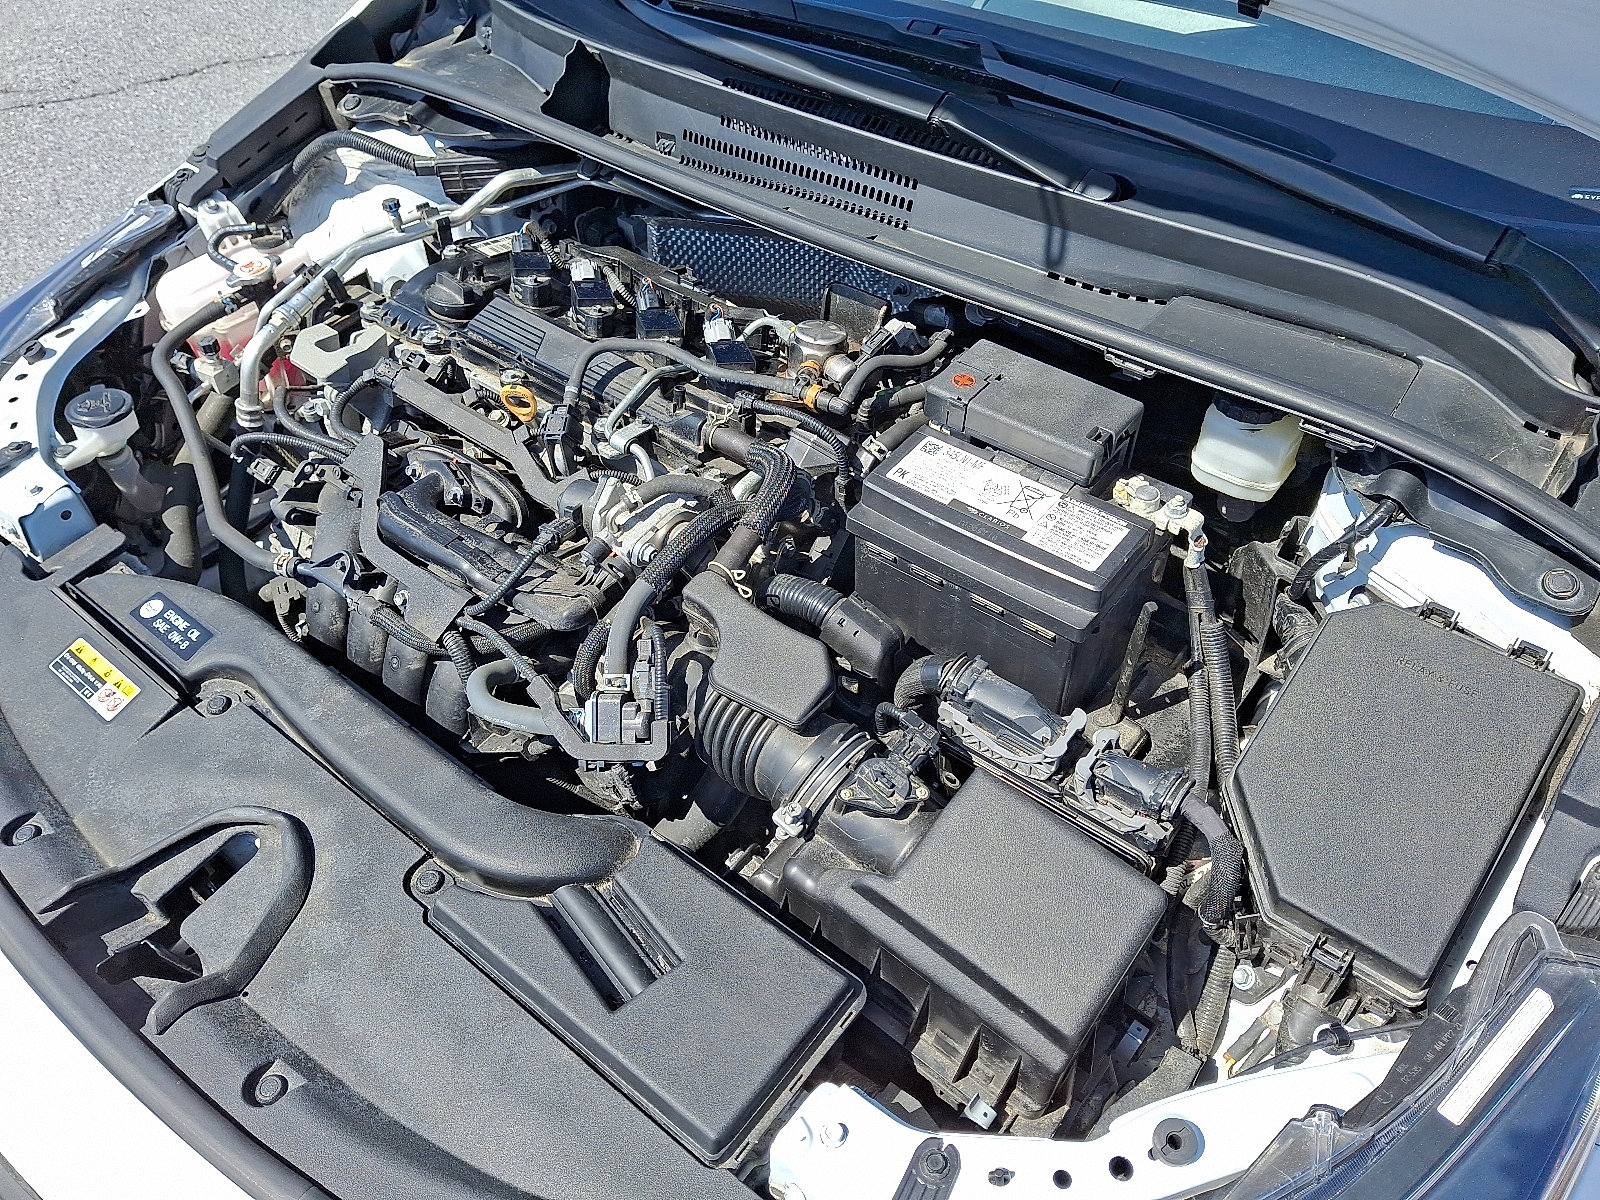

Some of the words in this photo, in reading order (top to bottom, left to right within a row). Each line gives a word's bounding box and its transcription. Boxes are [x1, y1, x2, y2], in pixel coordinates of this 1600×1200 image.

[892, 467, 908, 480] PK
[977, 512, 1011, 529] CLARIOS
[152, 618, 170, 633] SAE
[167, 631, 190, 650] 0W-8
[164, 609, 190, 632] ENGINE
[187, 628, 201, 642] OIL
[1396, 656, 1434, 677] RELAY
[1449, 681, 1481, 697] FUSE
